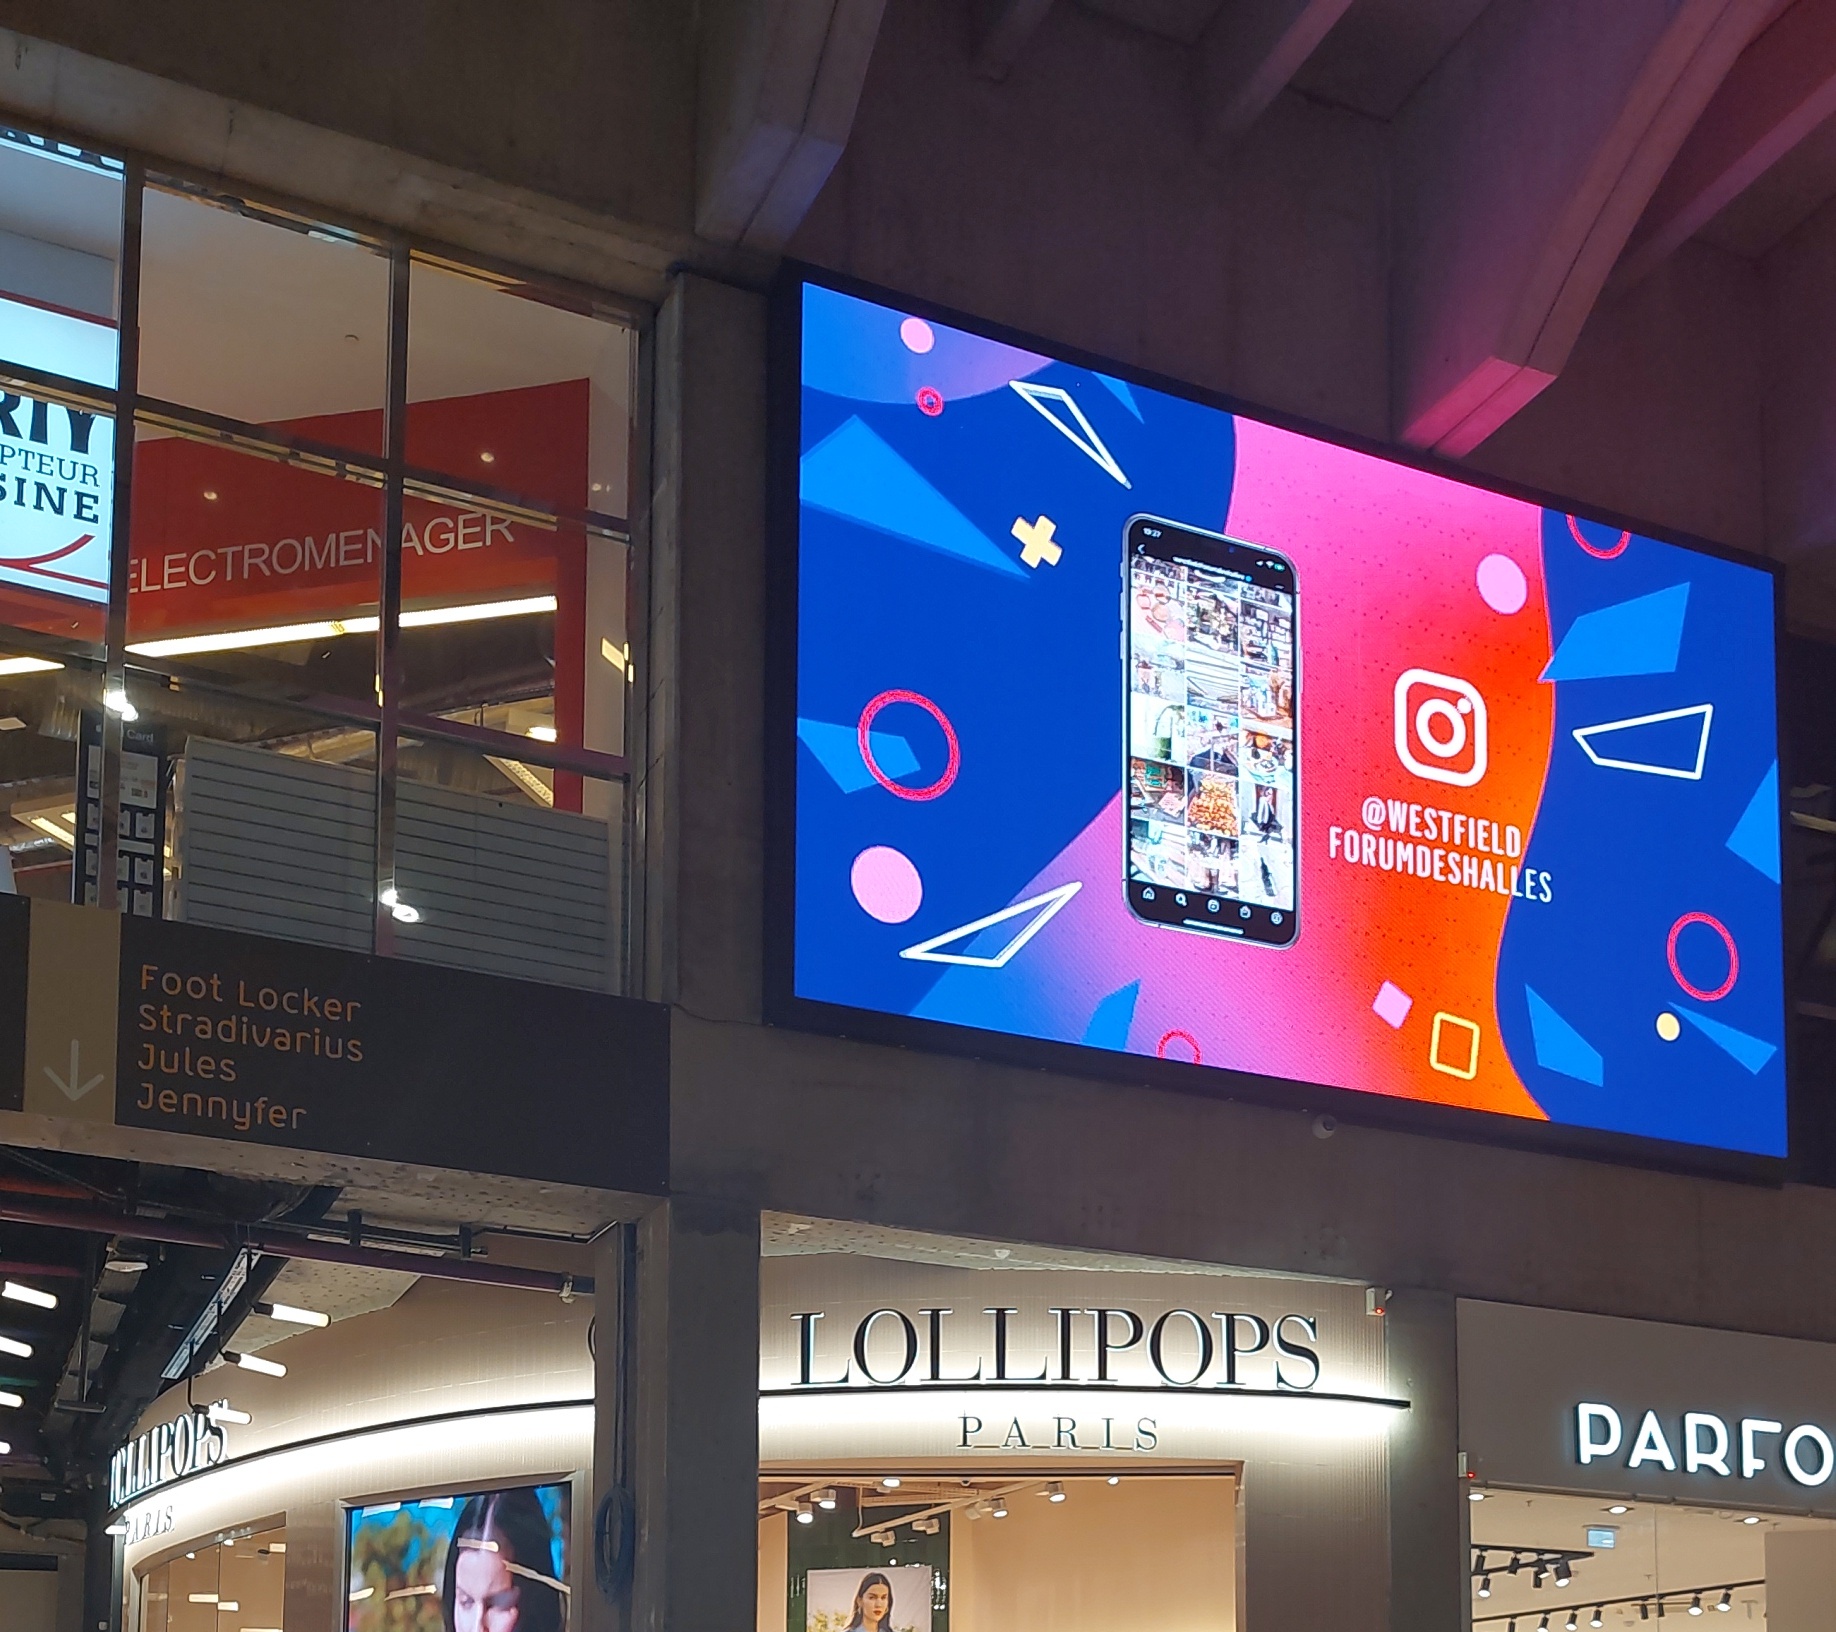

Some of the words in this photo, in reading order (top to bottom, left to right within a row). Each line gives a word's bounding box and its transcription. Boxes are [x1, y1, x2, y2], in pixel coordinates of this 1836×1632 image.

[1361, 795, 1522, 858] @WESTFIELD
[1328, 825, 1553, 903] FORUMDESHALLES
[140, 964, 223, 1003] Foot
[239, 980, 361, 1023] Locker
[138, 1003, 364, 1062] Stradivarius
[137, 1043, 237, 1082] Jules
[136, 1082, 307, 1131] Jennyfer
[790, 1307, 1321, 1390] LOLLIPOPS
[956, 1415, 1159, 1452] PARIS
[1574, 1402, 1835, 1486] PARFO
